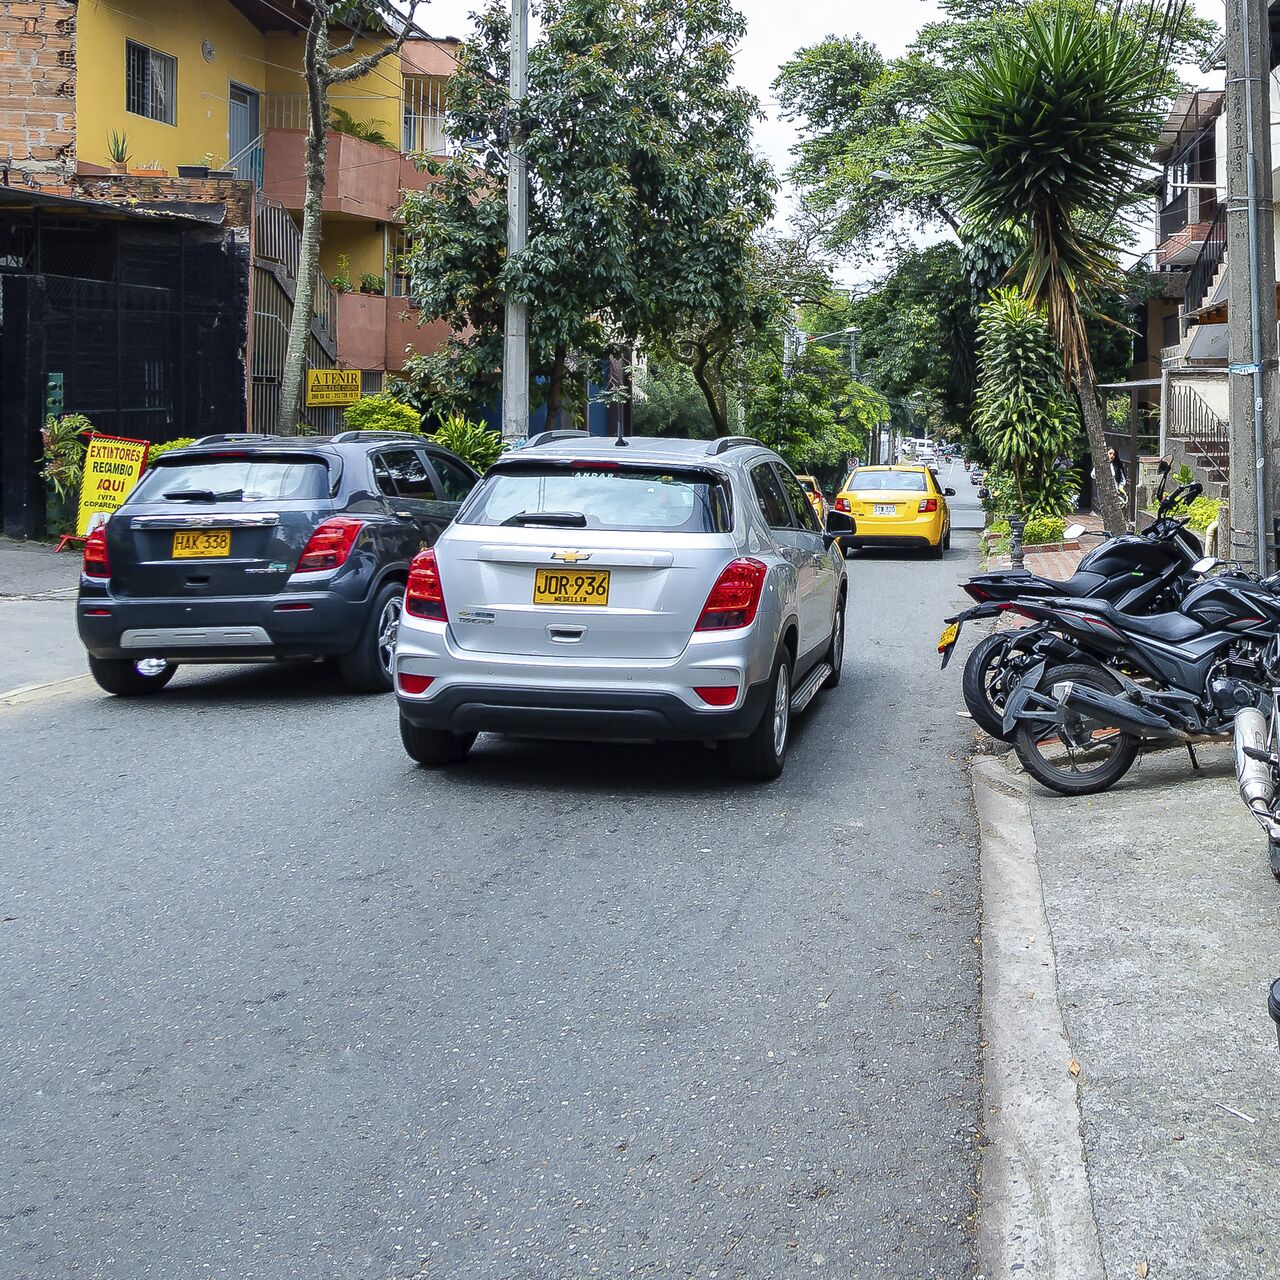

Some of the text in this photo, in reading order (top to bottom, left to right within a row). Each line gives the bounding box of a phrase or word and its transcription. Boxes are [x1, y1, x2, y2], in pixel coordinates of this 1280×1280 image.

[313, 373, 321, 385] A
[92, 461, 133, 477] RECAMBIO
[175, 535, 228, 550] HAK 338
[537, 575, 607, 595] JOR 936
